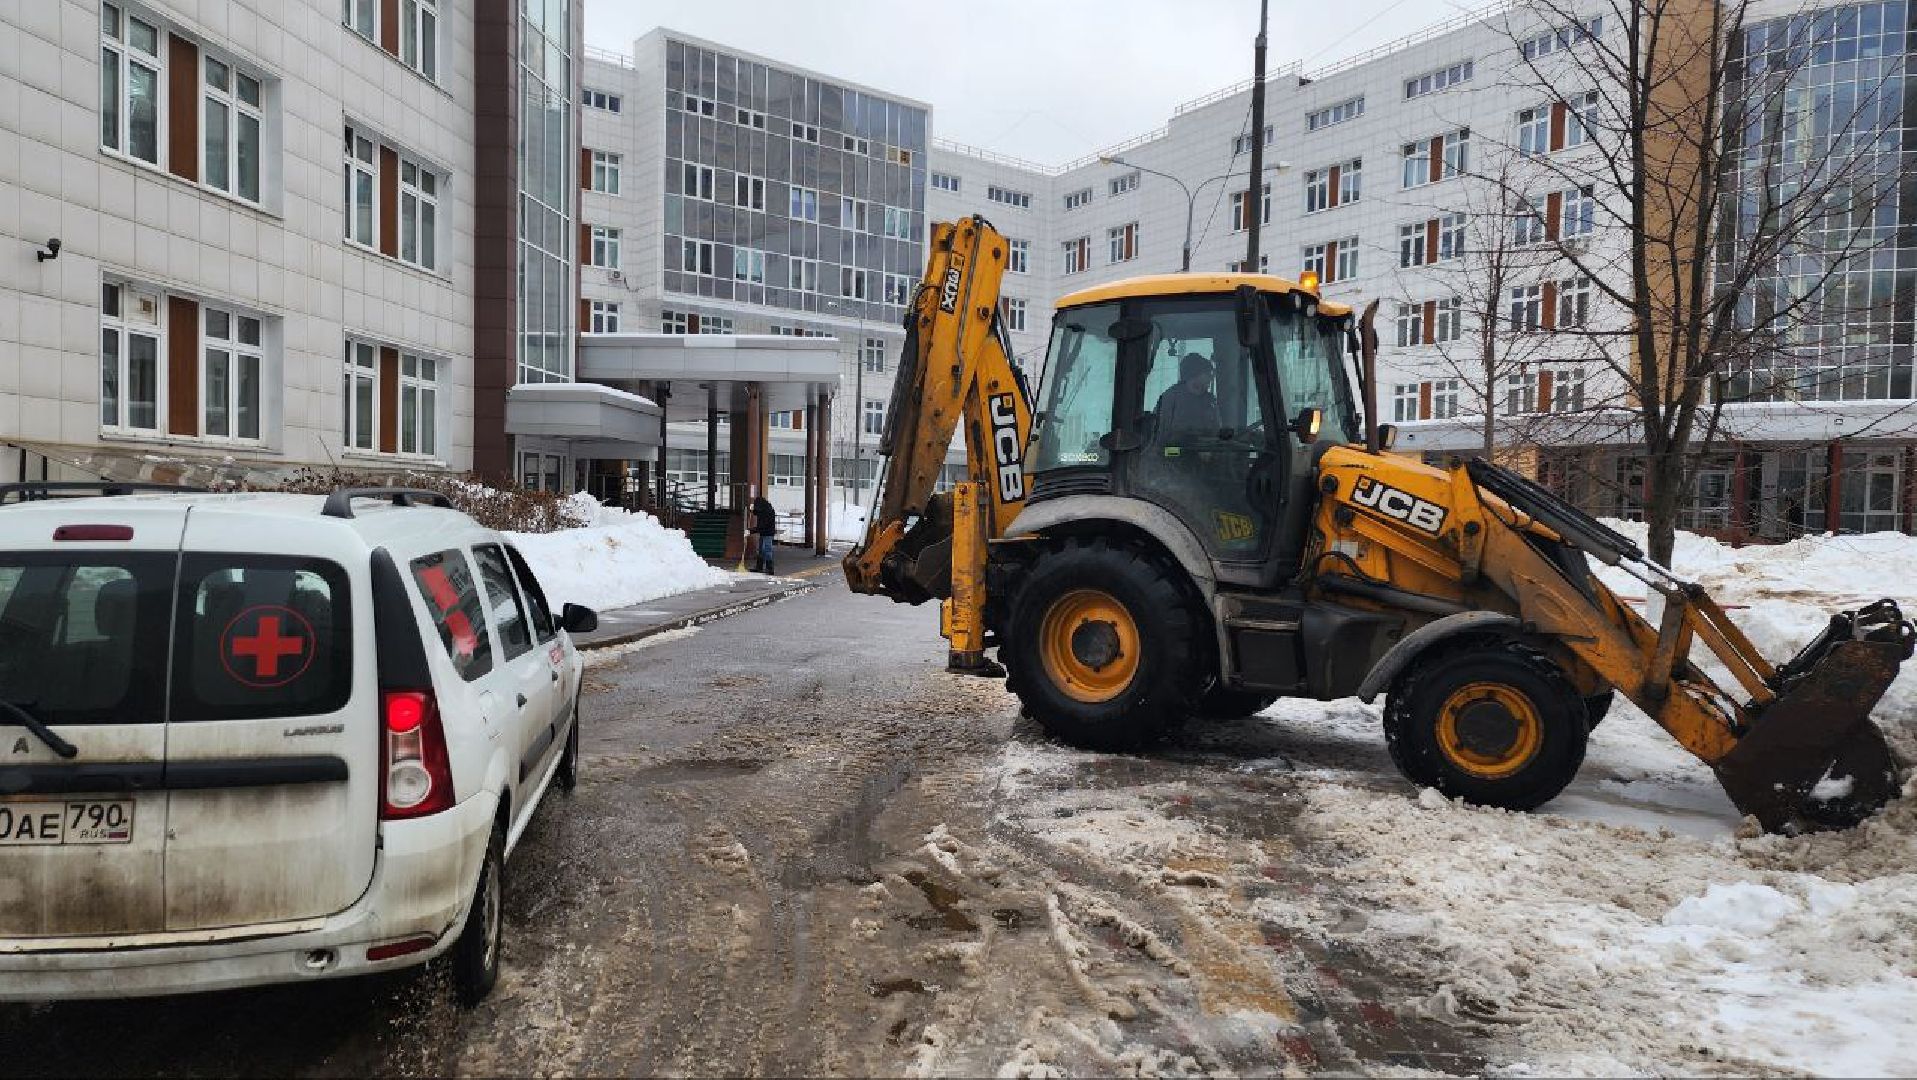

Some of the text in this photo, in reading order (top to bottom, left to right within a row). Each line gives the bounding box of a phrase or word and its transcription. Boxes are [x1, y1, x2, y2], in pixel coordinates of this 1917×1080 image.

[991, 397, 1022, 501] JCB
[1354, 482, 1444, 532] JCB
[1219, 514, 1253, 540] JCB
[12, 737, 30, 754] A
[69, 803, 123, 830] 790
[80, 828, 107, 839] RUS
